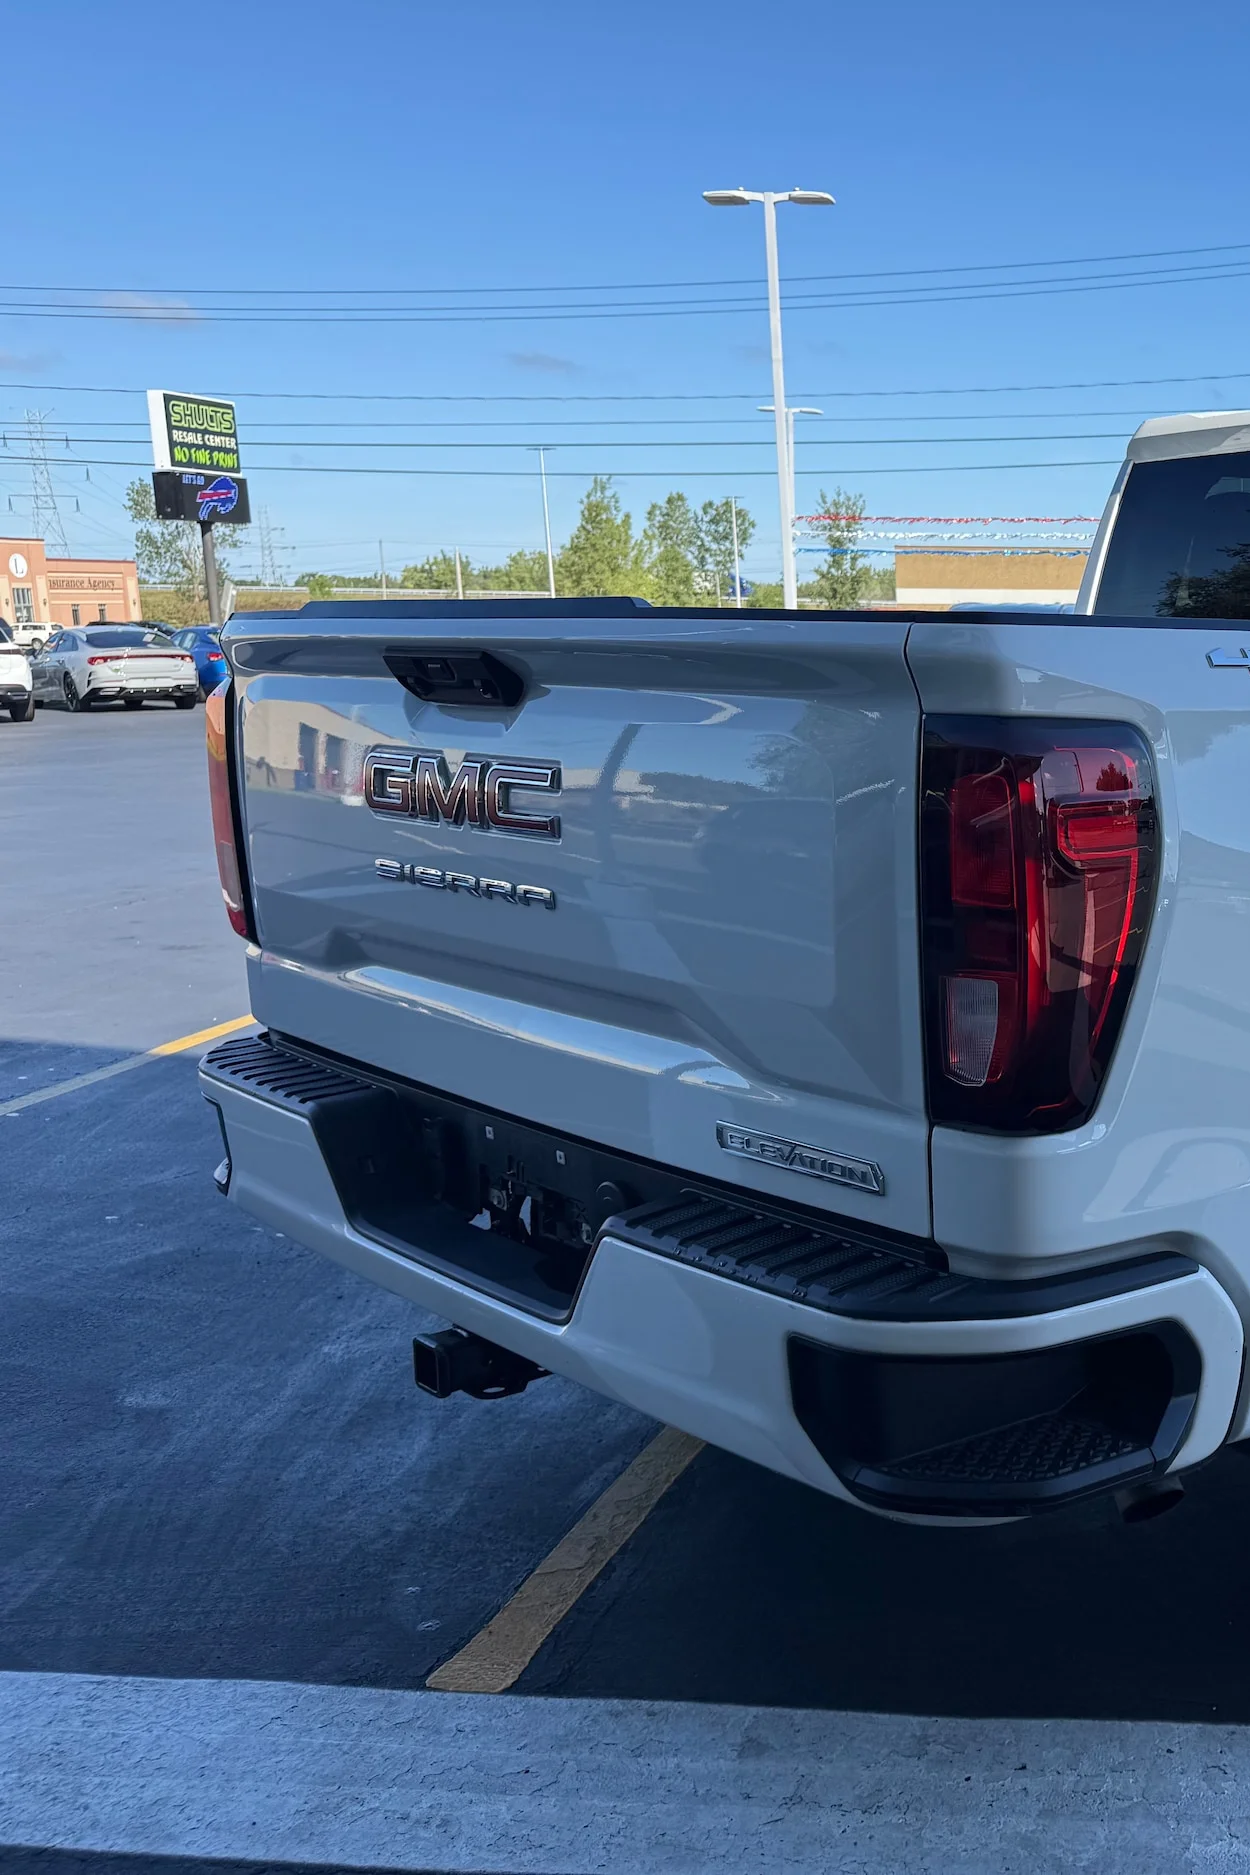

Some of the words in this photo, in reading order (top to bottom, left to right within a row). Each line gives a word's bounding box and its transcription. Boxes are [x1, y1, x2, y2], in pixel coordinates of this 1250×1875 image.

[169, 400, 235, 433] SHULTS
[172, 429, 203, 446] RESALE
[205, 434, 237, 450] CENTER
[174, 445, 189, 463] NO
[191, 448, 211, 466] FINE
[212, 450, 238, 468] PRINT
[88, 577, 115, 591] Agency
[363, 752, 562, 840] GMC
[374, 858, 557, 911] SIERRA
[727, 1132, 868, 1184] ELEVATION
